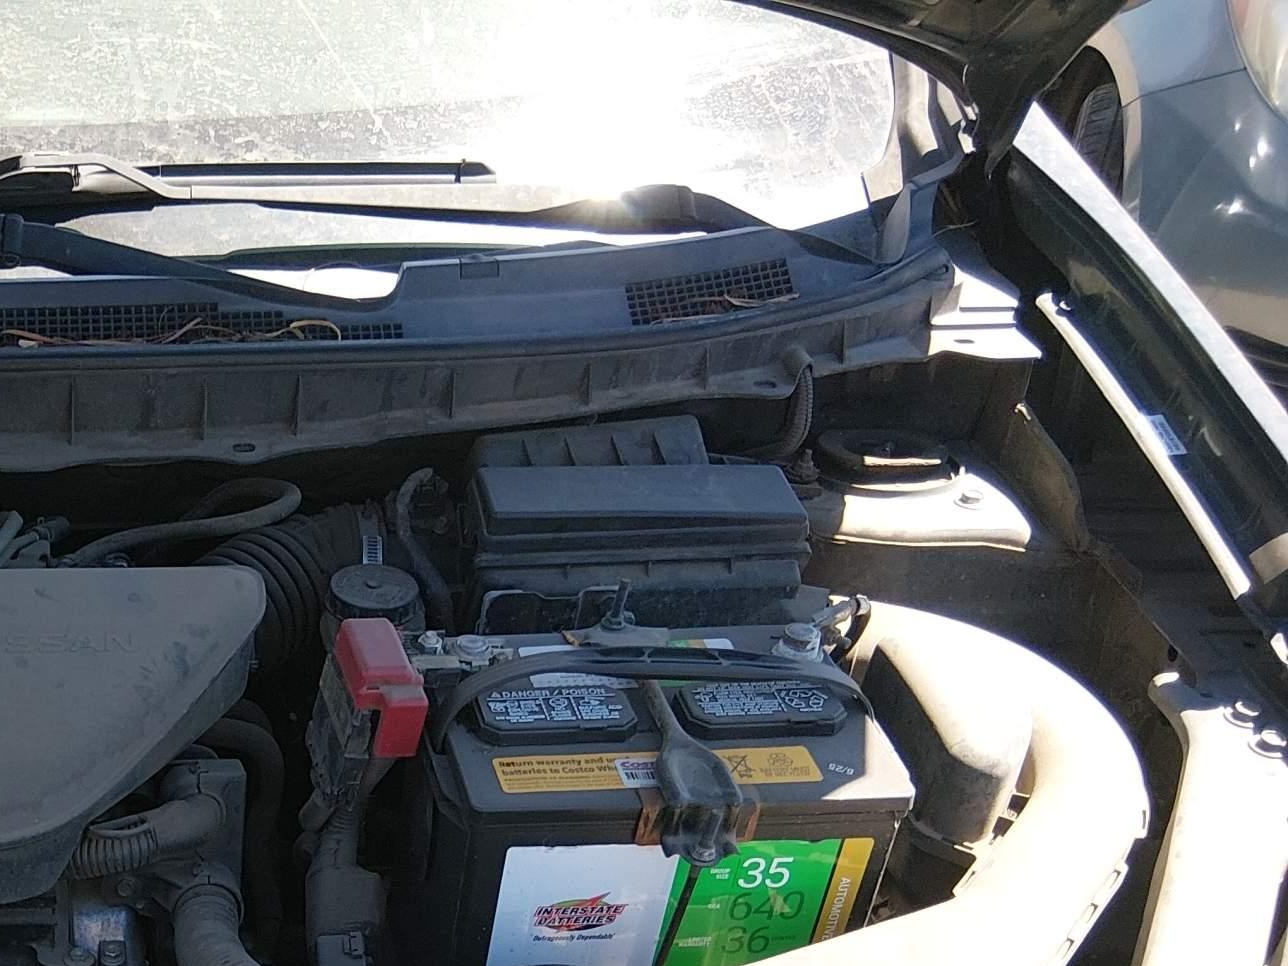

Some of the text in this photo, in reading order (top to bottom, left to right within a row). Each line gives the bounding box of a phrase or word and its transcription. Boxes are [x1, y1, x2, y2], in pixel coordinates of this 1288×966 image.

[502, 690, 550, 698] DANGER
[562, 688, 606, 696] POISON
[498, 760, 534, 768] Return
[535, 758, 581, 767] warranty
[584, 756, 604, 765] and
[502, 767, 548, 776] batteries
[561, 766, 594, 774] Costco
[737, 857, 794, 889] 35
[536, 905, 623, 916] INTERSTATE
[728, 890, 805, 921] 640
[537, 915, 616, 926] BATTERIES
[722, 926, 771, 954] 36
